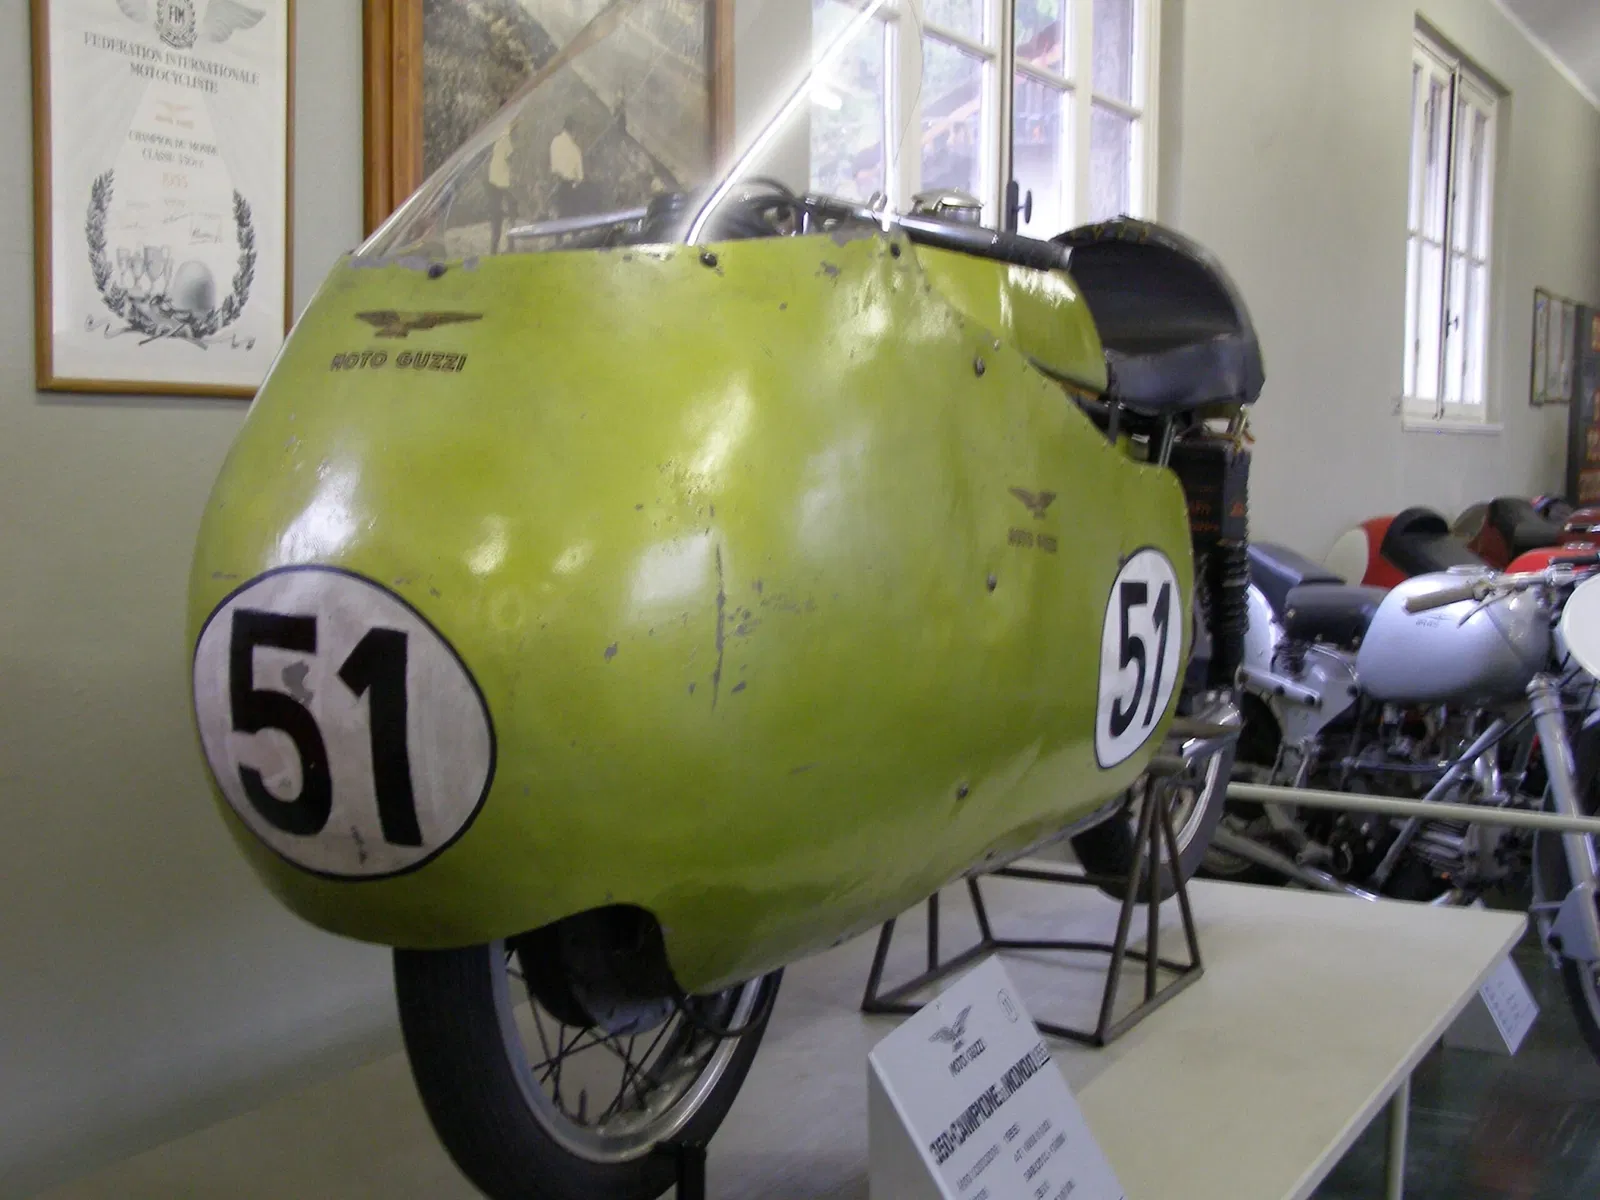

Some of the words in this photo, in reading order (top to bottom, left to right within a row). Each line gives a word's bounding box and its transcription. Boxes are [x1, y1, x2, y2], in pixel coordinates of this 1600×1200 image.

[395, 351, 469, 373] GUZZI
[229, 608, 423, 846] 51
[1109, 581, 1170, 737] 51
